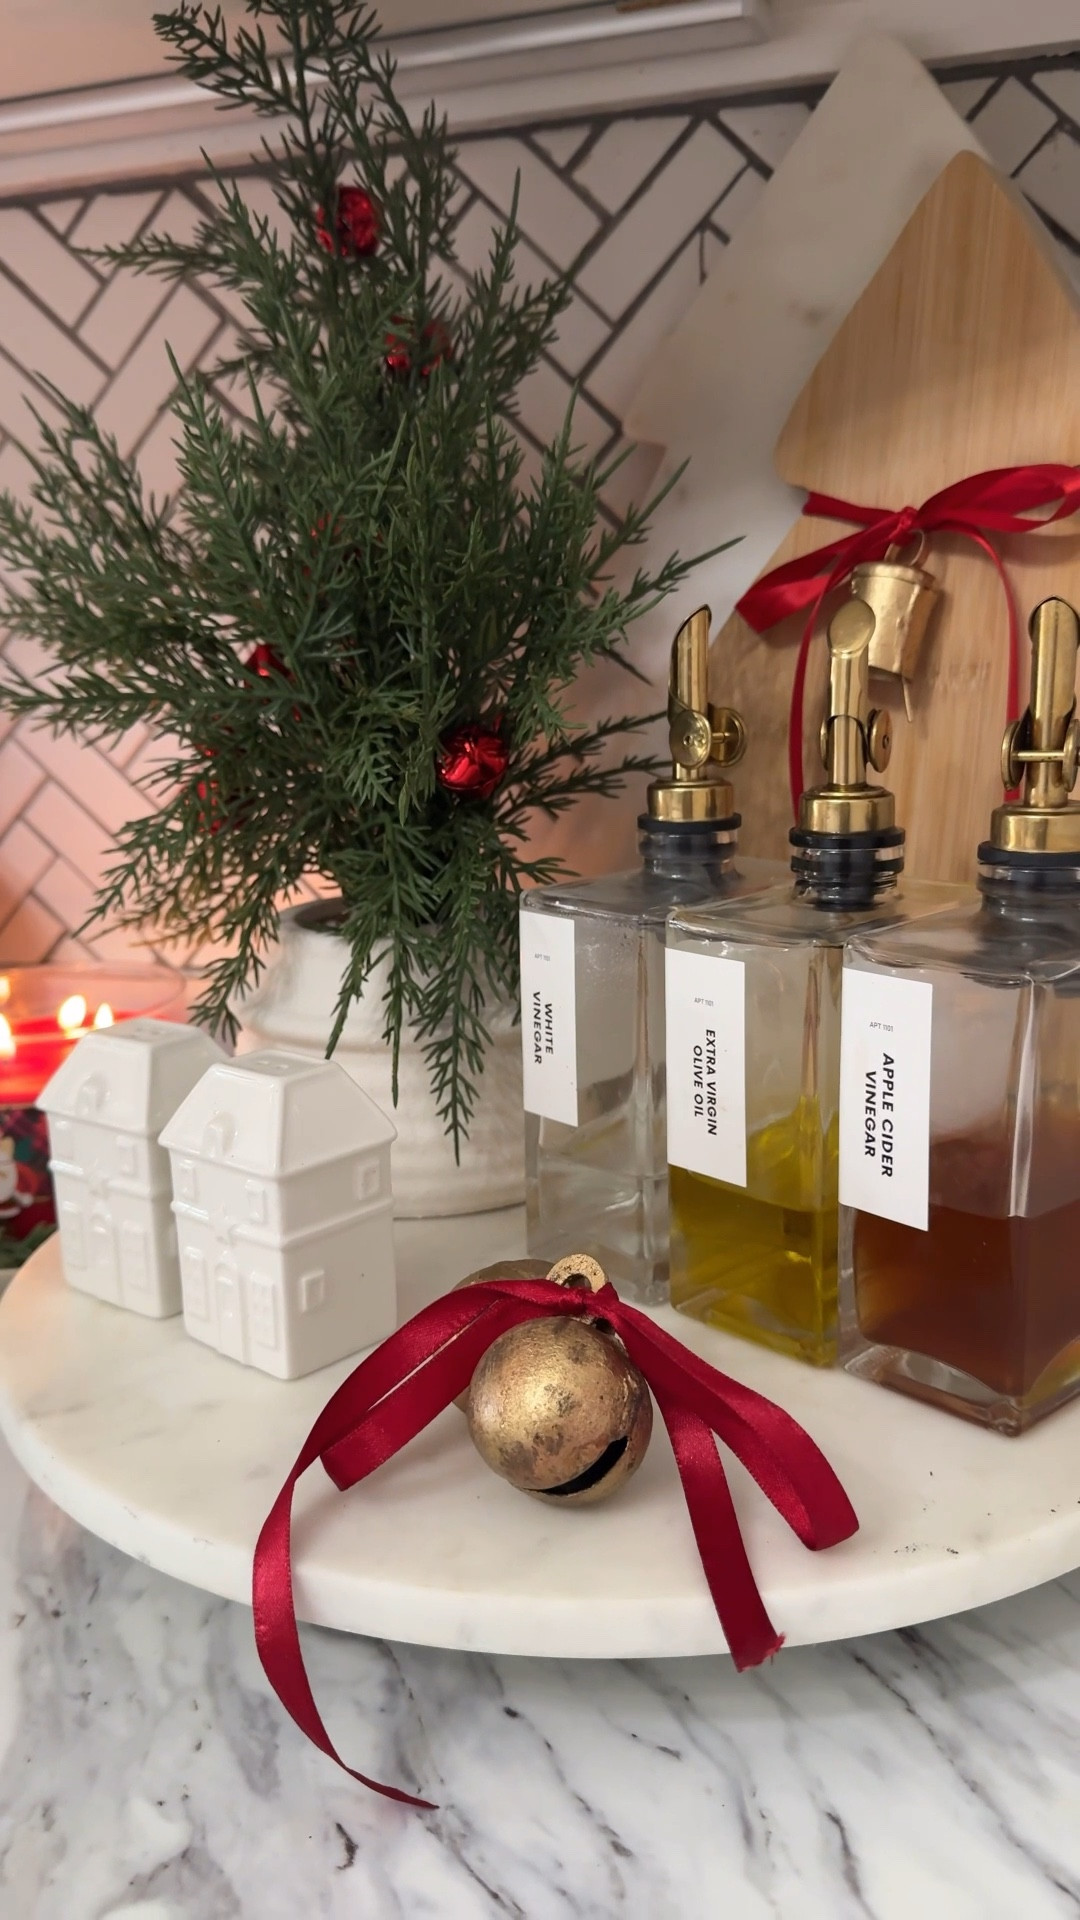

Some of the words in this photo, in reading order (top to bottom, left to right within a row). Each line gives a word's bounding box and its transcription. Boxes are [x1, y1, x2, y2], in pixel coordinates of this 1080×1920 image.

[532, 991, 543, 1065] VINEGAR
[544, 1003, 554, 1054] WHITE
[869, 1021, 881, 1029] APT
[693, 1045, 704, 1089] OLIVE
[705, 1029, 717, 1075] EXTRA
[693, 1093, 704, 1117] OIL
[706, 1081, 719, 1136] VIRGIN
[882, 1052, 895, 1112] APPLE
[864, 1070, 877, 1158] VINEGAR
[881, 1118, 894, 1178] CIDER
